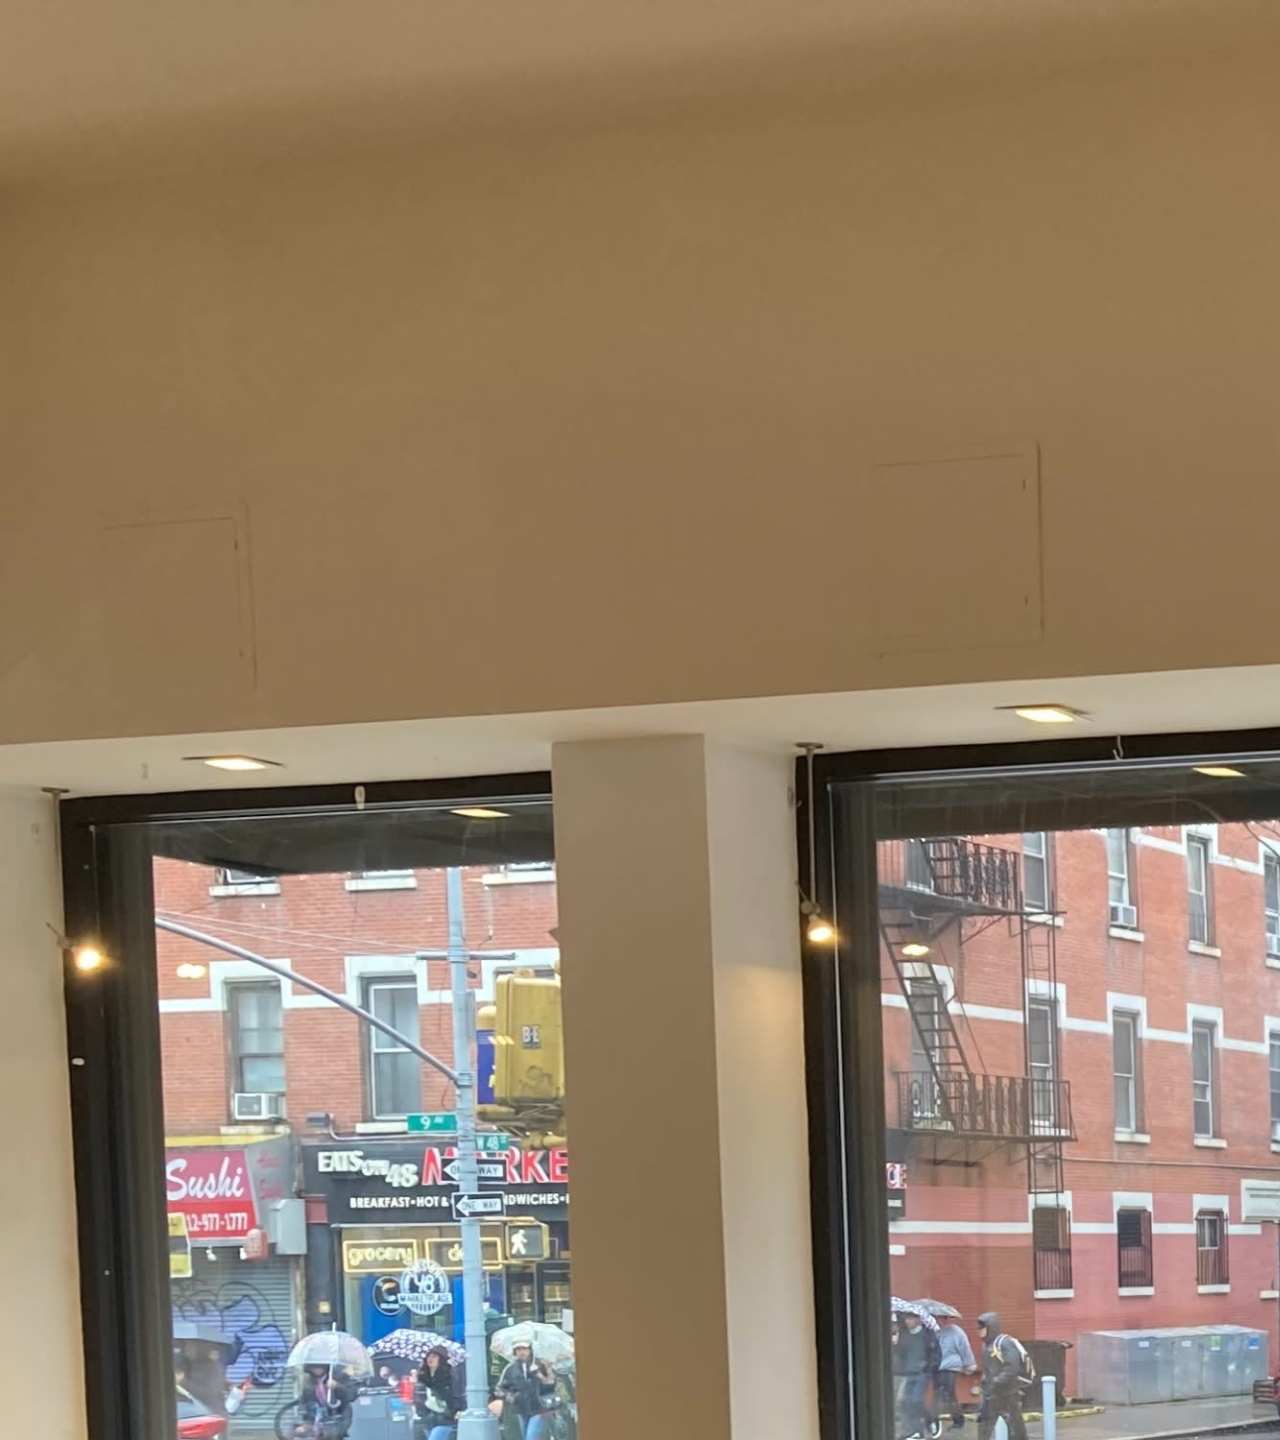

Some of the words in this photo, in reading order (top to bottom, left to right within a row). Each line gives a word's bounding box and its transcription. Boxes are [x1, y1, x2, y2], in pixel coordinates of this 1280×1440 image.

[420, 1116, 431, 1130] 9
[486, 1136, 500, 1150] 48
[318, 1150, 364, 1172] EATS
[385, 1163, 418, 1188] 48
[166, 1156, 244, 1201] Sushi
[350, 1196, 411, 1209] BREAKFAST
[417, 1196, 440, 1208] HOT
[348, 1246, 413, 1266] grocery
